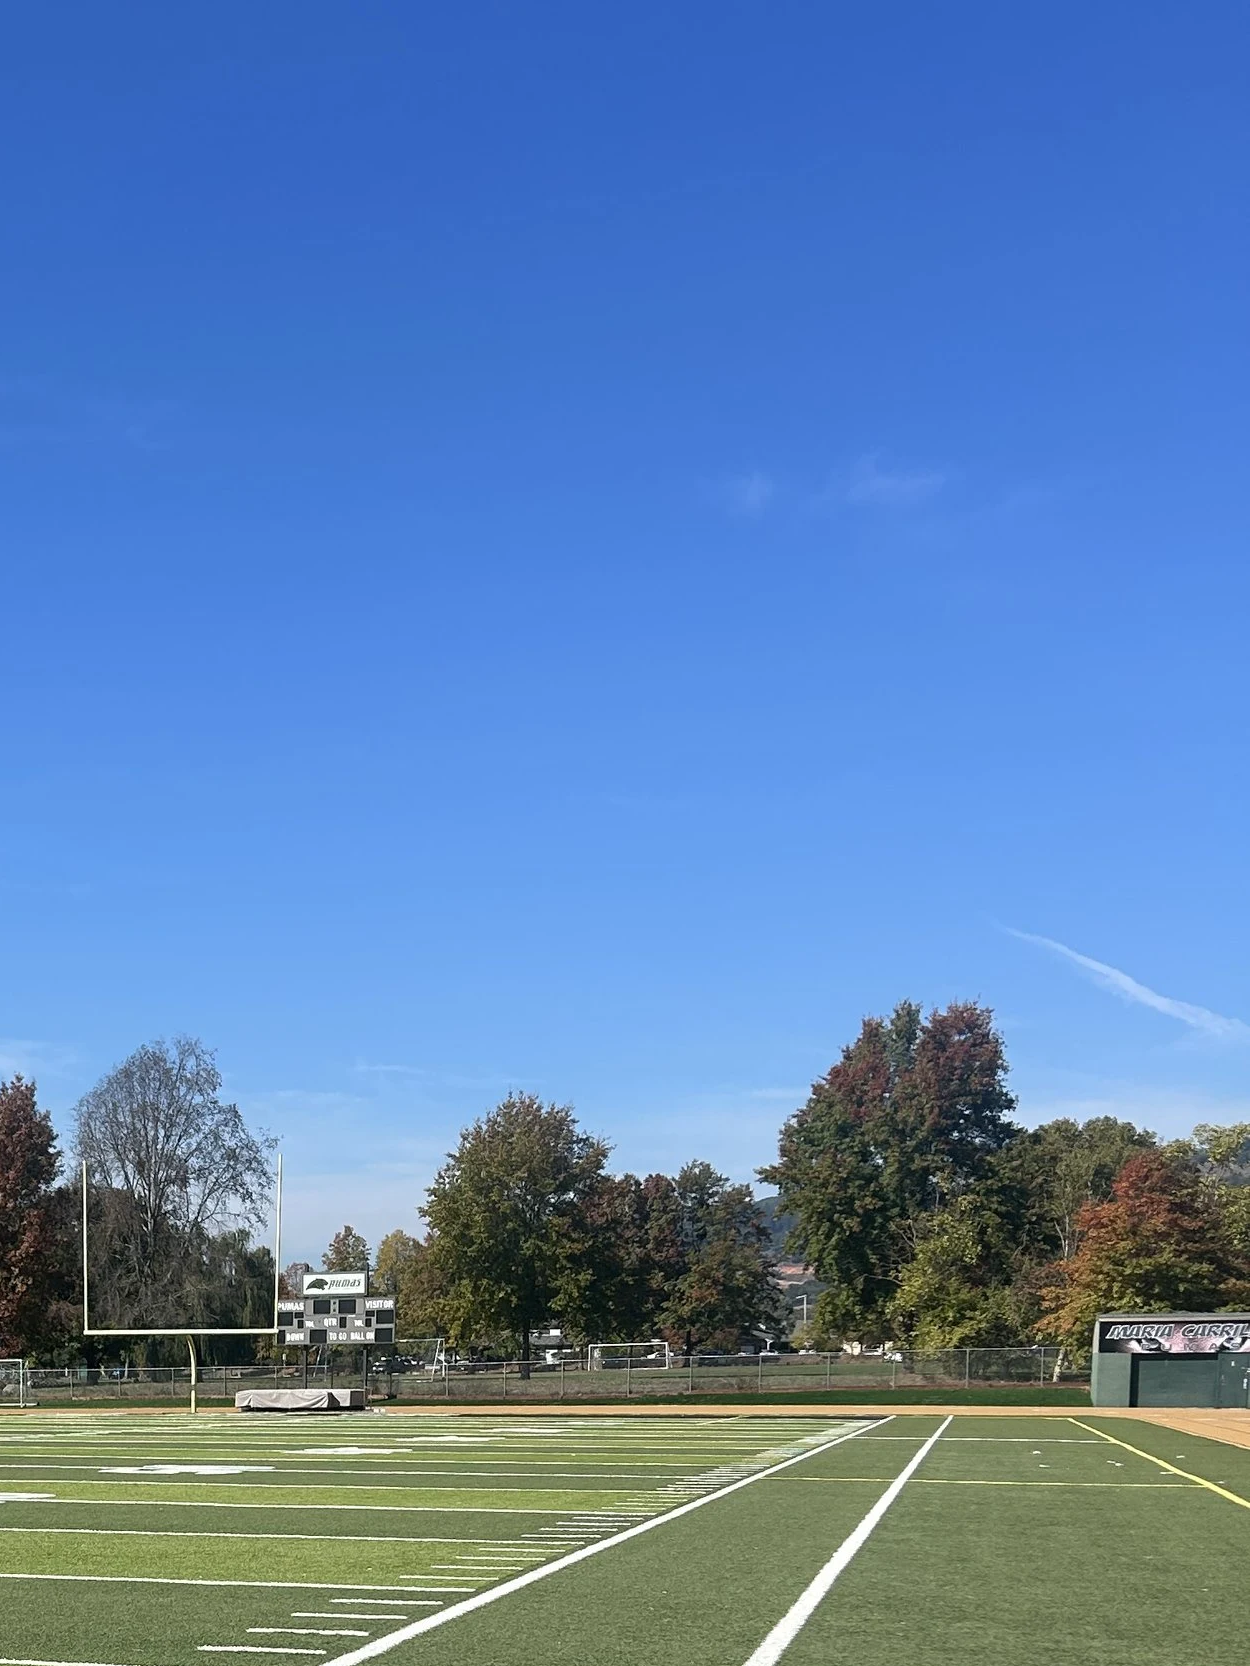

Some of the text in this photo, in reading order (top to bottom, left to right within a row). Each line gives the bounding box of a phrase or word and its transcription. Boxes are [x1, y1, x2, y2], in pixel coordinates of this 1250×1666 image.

[365, 1300, 394, 1309] VISITOR
[323, 1318, 337, 1326] QTR
[329, 1332, 347, 1340] TO GO
[350, 1331, 365, 1340] BALL
[1105, 1324, 1175, 1340] MARIA
